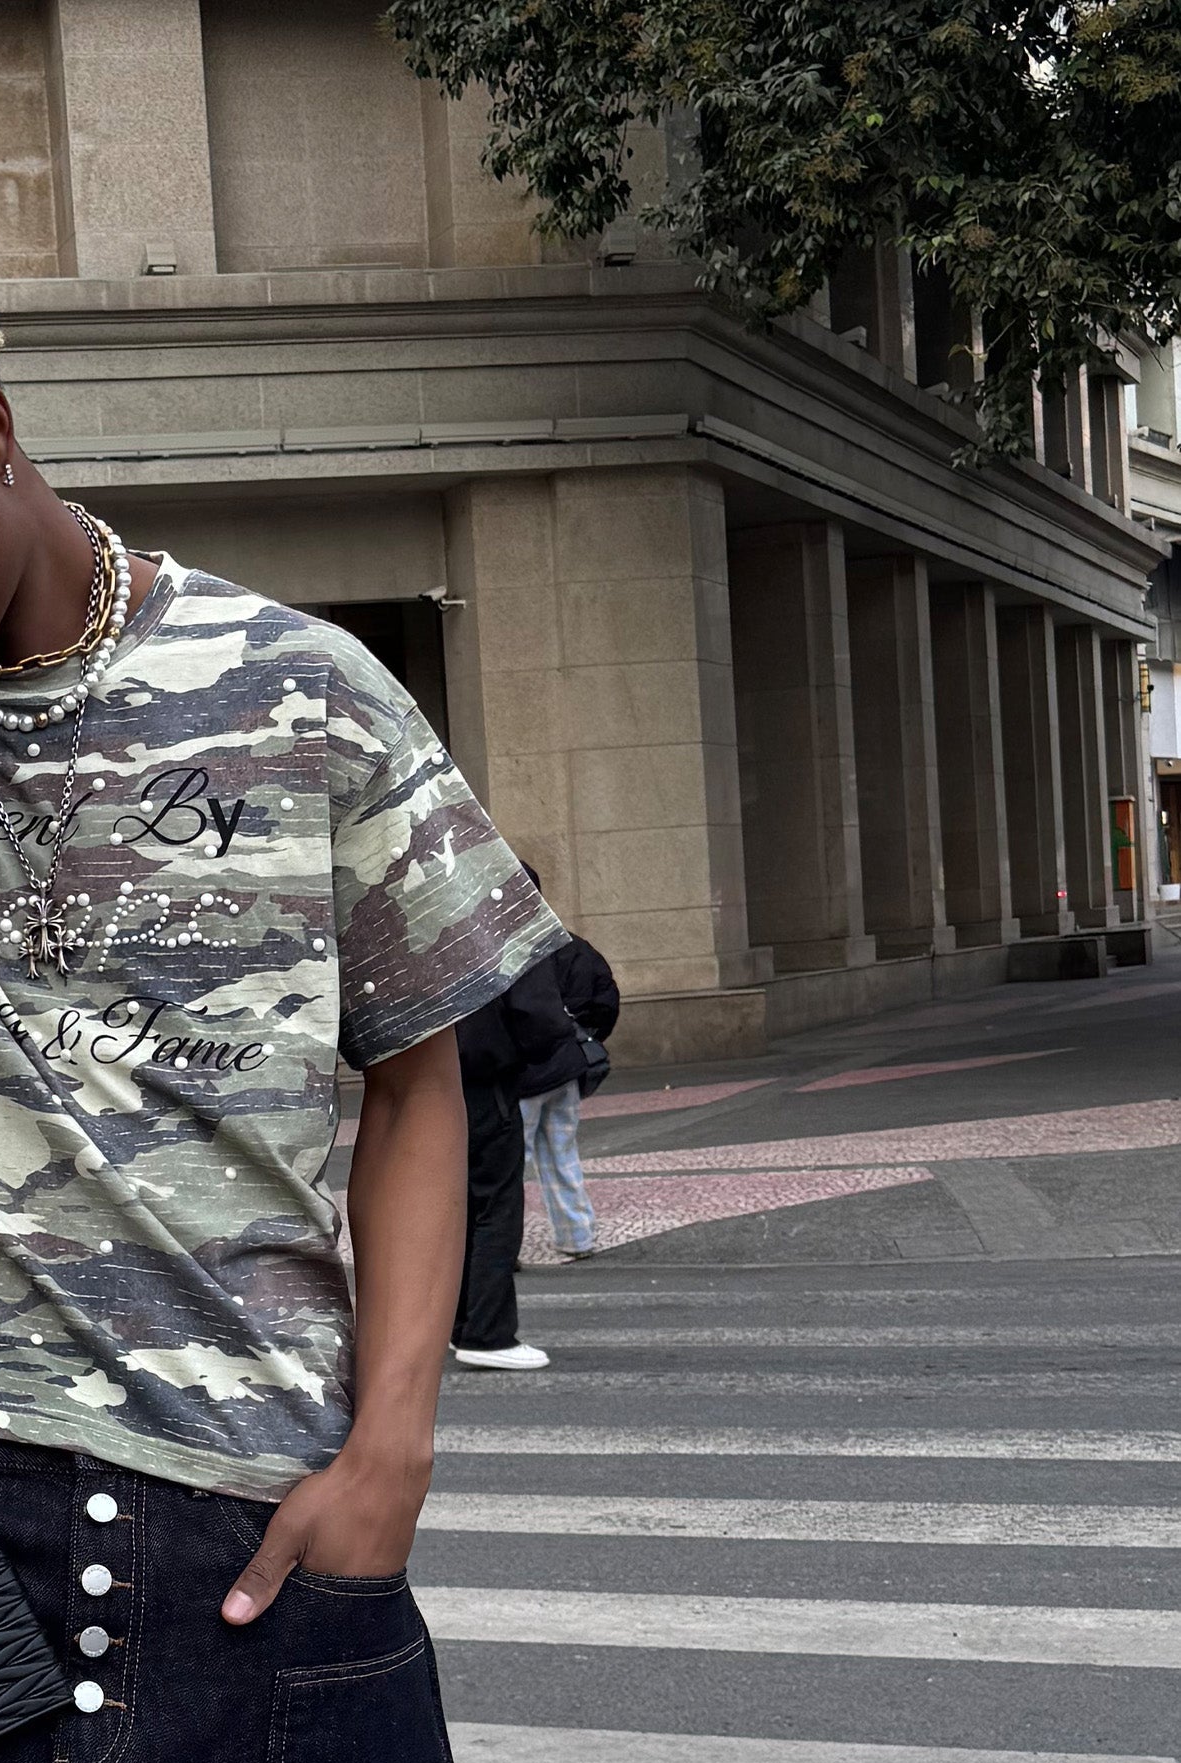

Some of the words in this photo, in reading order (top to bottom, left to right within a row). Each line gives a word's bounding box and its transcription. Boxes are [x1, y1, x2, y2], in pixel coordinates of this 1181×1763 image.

[114, 767, 245, 858] By
[43, 1010, 82, 1066] &
[90, 996, 269, 1072] Fame
